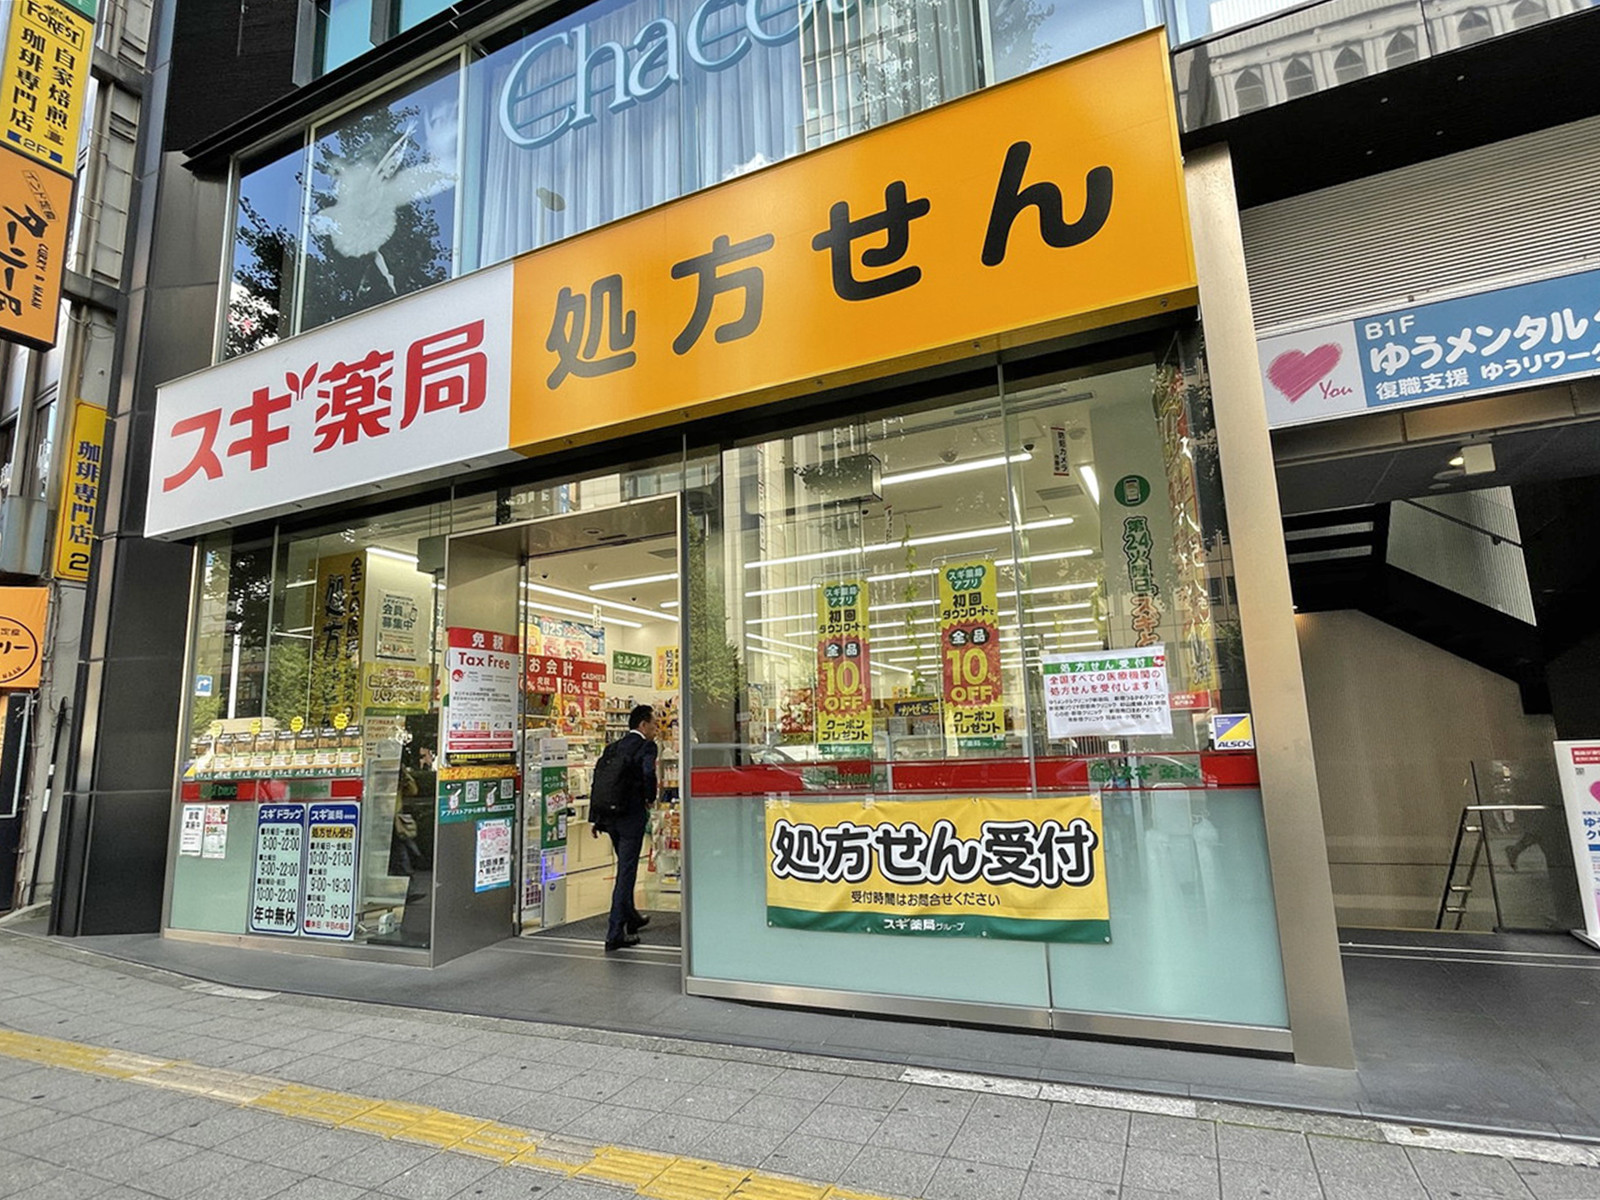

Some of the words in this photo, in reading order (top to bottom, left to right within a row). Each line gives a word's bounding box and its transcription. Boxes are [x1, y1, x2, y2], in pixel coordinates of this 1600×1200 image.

[27, 0, 80, 44] FOREST
[10, 27, 46, 133] 珈琲専門店
[499, 0, 858, 149] Chaco
[45, 46, 76, 130] 自家焙煎
[23, 137, 46, 154] 2F
[545, 140, 1114, 391] 処方せん
[1364, 314, 1416, 341] B1F
[1369, 307, 1600, 377] ゆうメンタル
[1318, 379, 1353, 400] You
[1375, 367, 1471, 401] 復職支援
[162, 318, 489, 494] スギ薬局
[68, 441, 101, 545] 珈琲専門店
[954, 578, 978, 590] アプリ
[953, 592, 982, 608] 初回
[382, 603, 403, 617] 会員
[829, 609, 856, 624] 初回
[471, 631, 504, 651] 免税
[952, 629, 985, 645] 全品
[826, 643, 858, 657] 全品
[458, 652, 484, 667] Tax
[488, 655, 511, 670] Free
[529, 657, 574, 677] お会計
[617, 655, 650, 667] セルフレジ
[1059, 658, 1146, 674] 処方せん受付
[1049, 669, 1161, 685] 全国すべての医療機関の
[563, 681, 580, 694] 10%
[950, 686, 993, 702] OFF
[824, 695, 862, 711] OFF
[826, 719, 865, 730] クーポン
[954, 711, 995, 722] クーポン
[821, 730, 869, 741] プレゼント
[1217, 740, 1252, 748] ALSOK
[260, 808, 304, 820] スギドラッグ
[1584, 816, 1600, 828] ゆ
[311, 825, 354, 839] 処方せん受付
[770, 818, 1098, 888] 処方せん受付
[851, 890, 1001, 907] 受付時間はお問合せください
[254, 906, 296, 927] 年中無休
[883, 917, 966, 931] スギ薬局グループ
